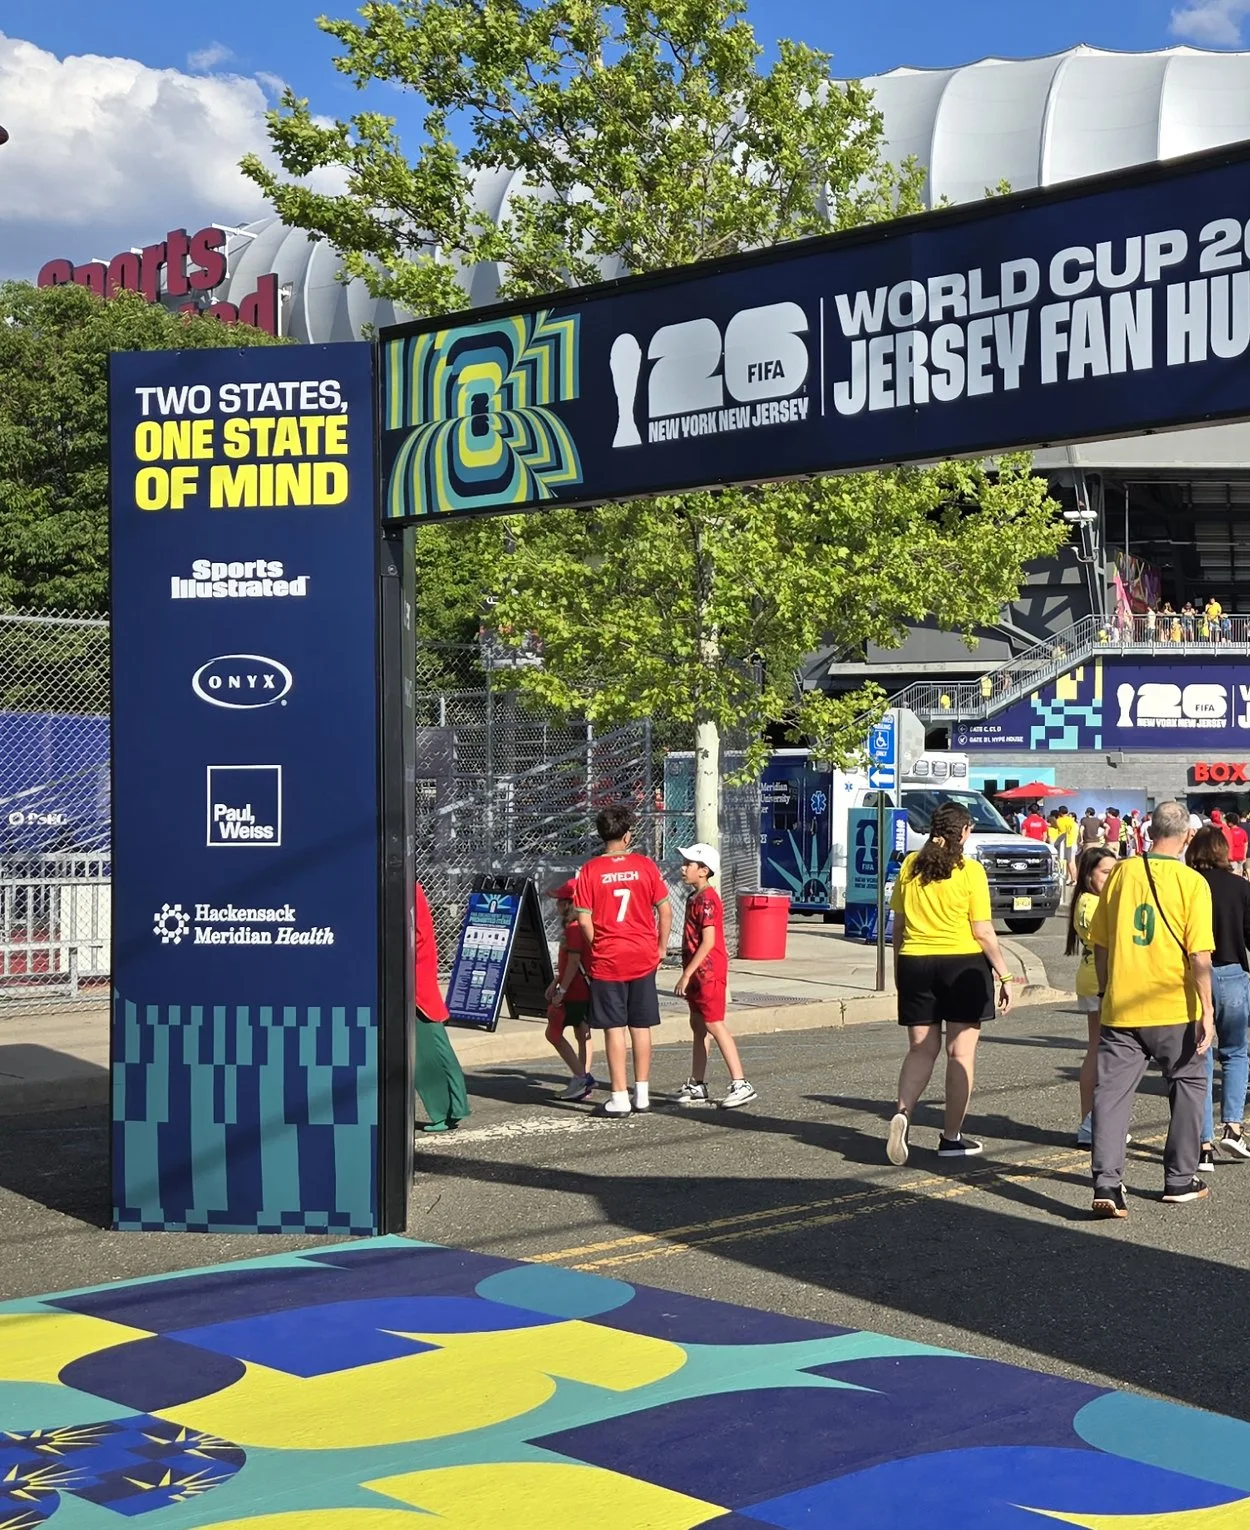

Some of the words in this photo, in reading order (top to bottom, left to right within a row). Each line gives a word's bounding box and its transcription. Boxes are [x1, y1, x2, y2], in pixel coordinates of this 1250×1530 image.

[835, 257, 1040, 337] WORLD
[1048, 228, 1188, 296] CUP
[648, 302, 809, 418] 26
[833, 306, 1028, 415] JERSEY
[1041, 288, 1151, 385] FAN
[748, 360, 785, 383] FIFA
[136, 384, 211, 416] TWO
[219, 379, 348, 415] STATES,
[649, 420, 680, 443] NEW
[682, 415, 717, 438] YORK
[719, 406, 750, 432] NEW
[752, 397, 809, 427] JERSEY
[135, 419, 213, 462] ONE
[223, 415, 348, 458] STATE
[135, 467, 198, 511] OF
[209, 462, 349, 508] MIND
[192, 559, 283, 580] Sports
[171, 575, 308, 599] Illustrated
[208, 674, 275, 689] ONYX
[1195, 762, 1248, 781] BOX
[214, 803, 255, 824] Paul,
[219, 821, 274, 839] Weiss
[601, 871, 639, 884] ZIYECH
[862, 863, 874, 871] FIFA
[194, 903, 296, 922] Hackensack
[613, 888, 631, 922] 7
[194, 926, 272, 944] Meridian
[275, 926, 334, 945] Health
[1132, 903, 1155, 946] 9
